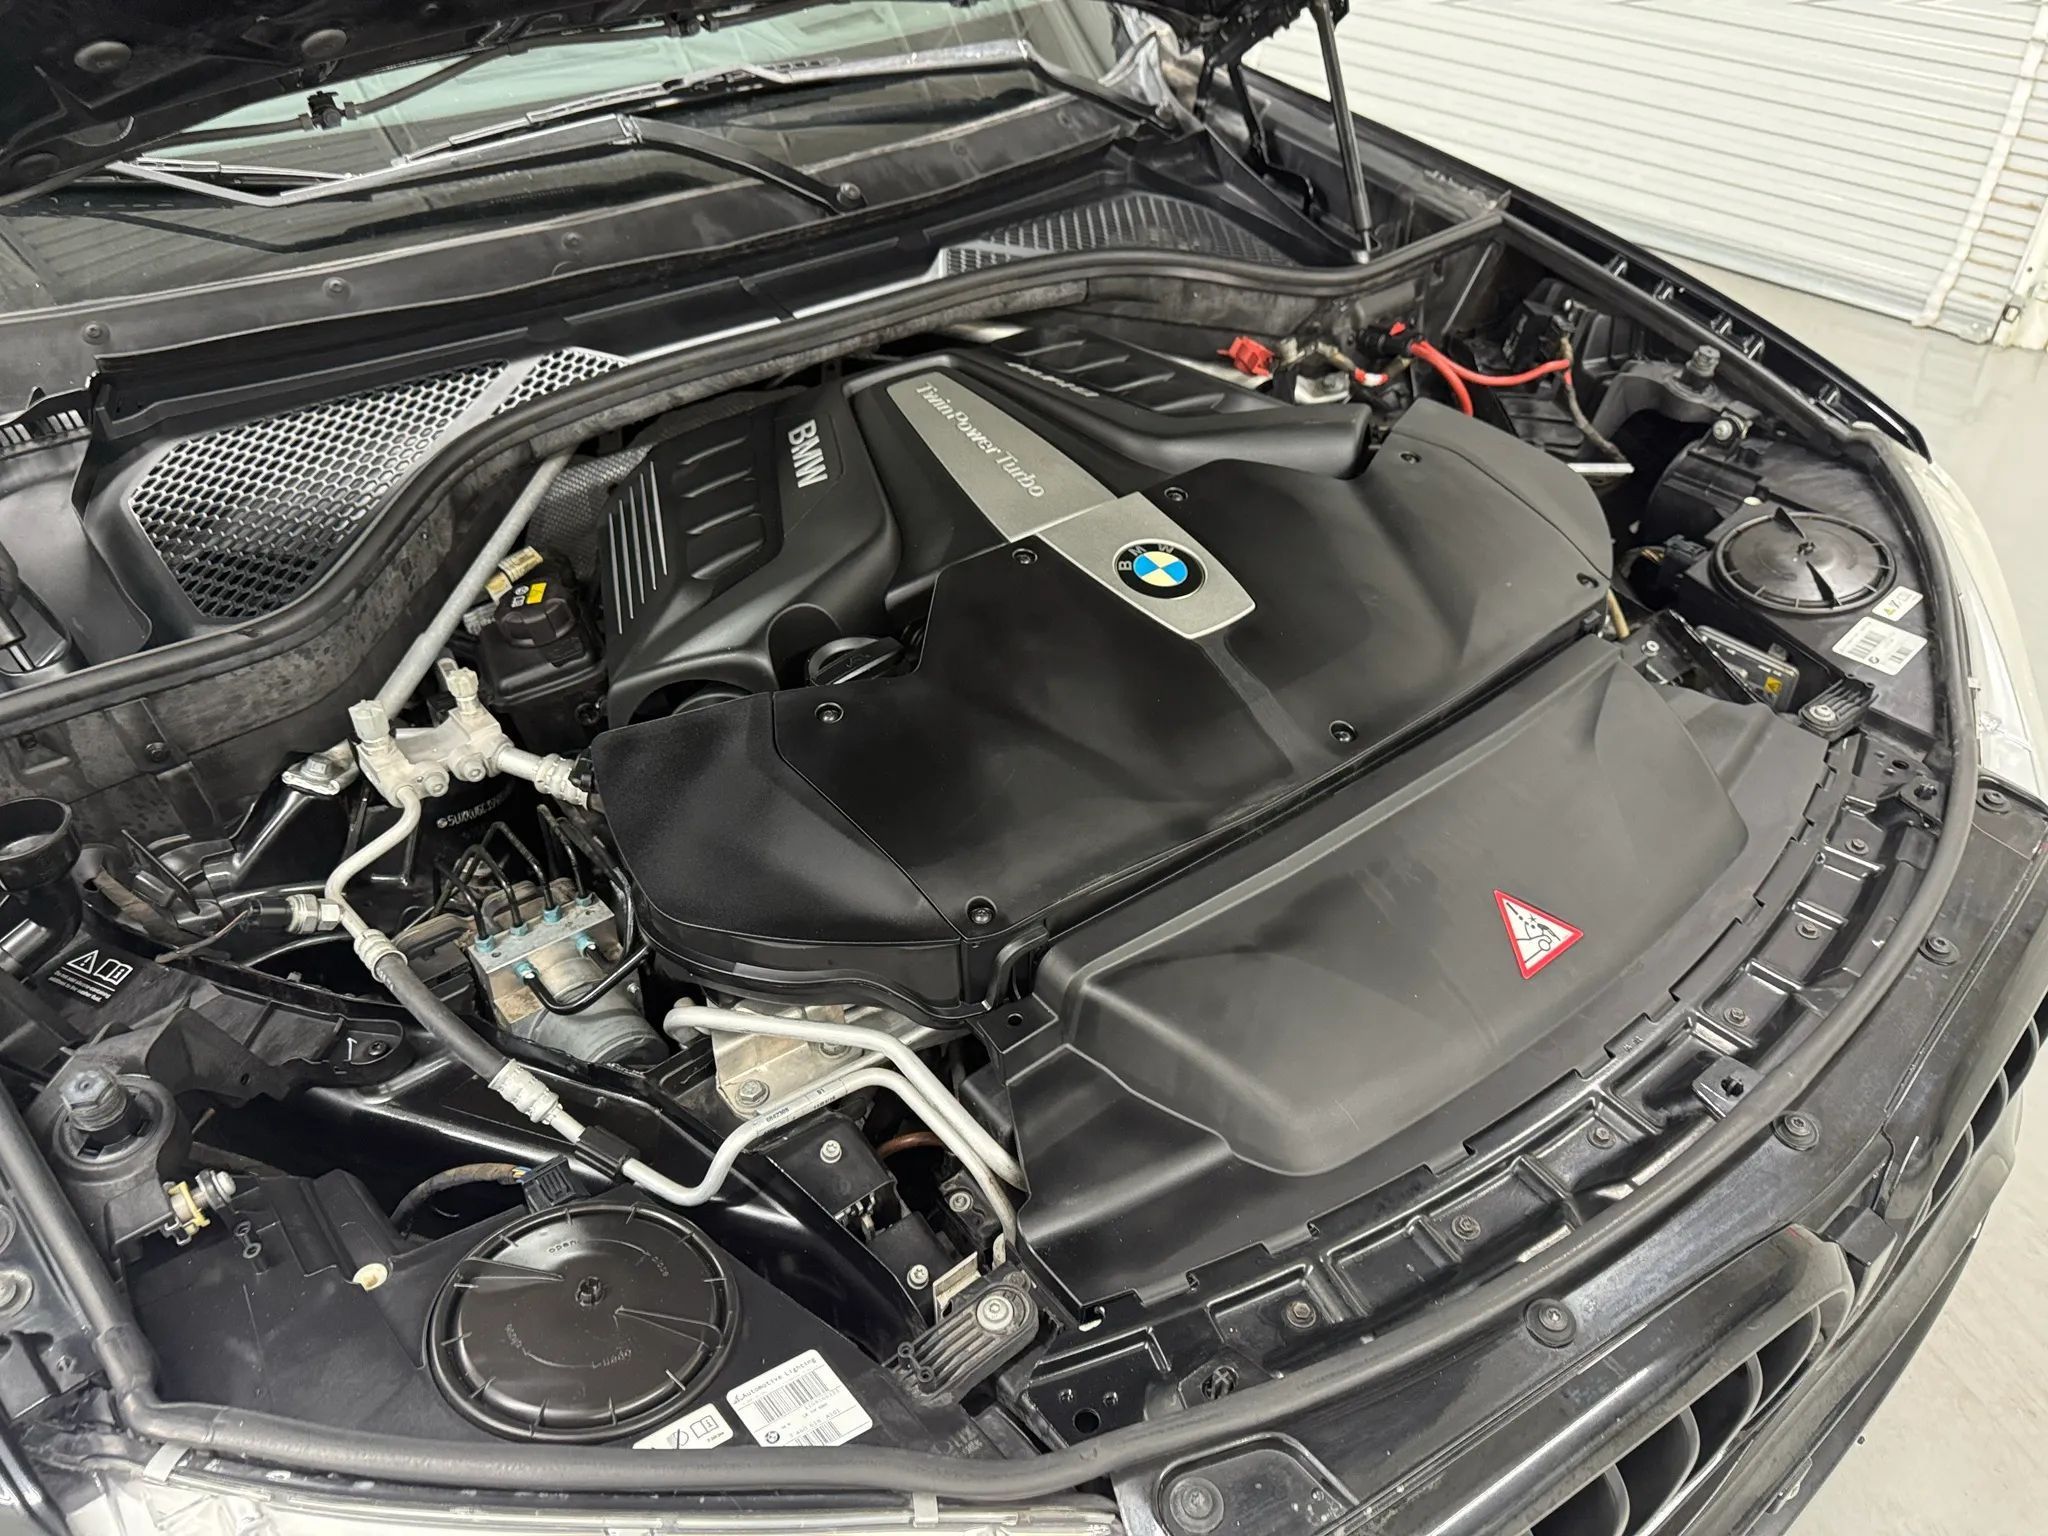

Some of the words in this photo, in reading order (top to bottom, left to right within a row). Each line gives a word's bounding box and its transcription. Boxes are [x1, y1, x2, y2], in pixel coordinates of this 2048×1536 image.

[787, 419, 828, 488] BMW
[996, 451, 1045, 497] Turbo
[1118, 544, 1174, 571] BMW
[742, 1375, 783, 1398] Automotive
[784, 1358, 817, 1377] Lighting
